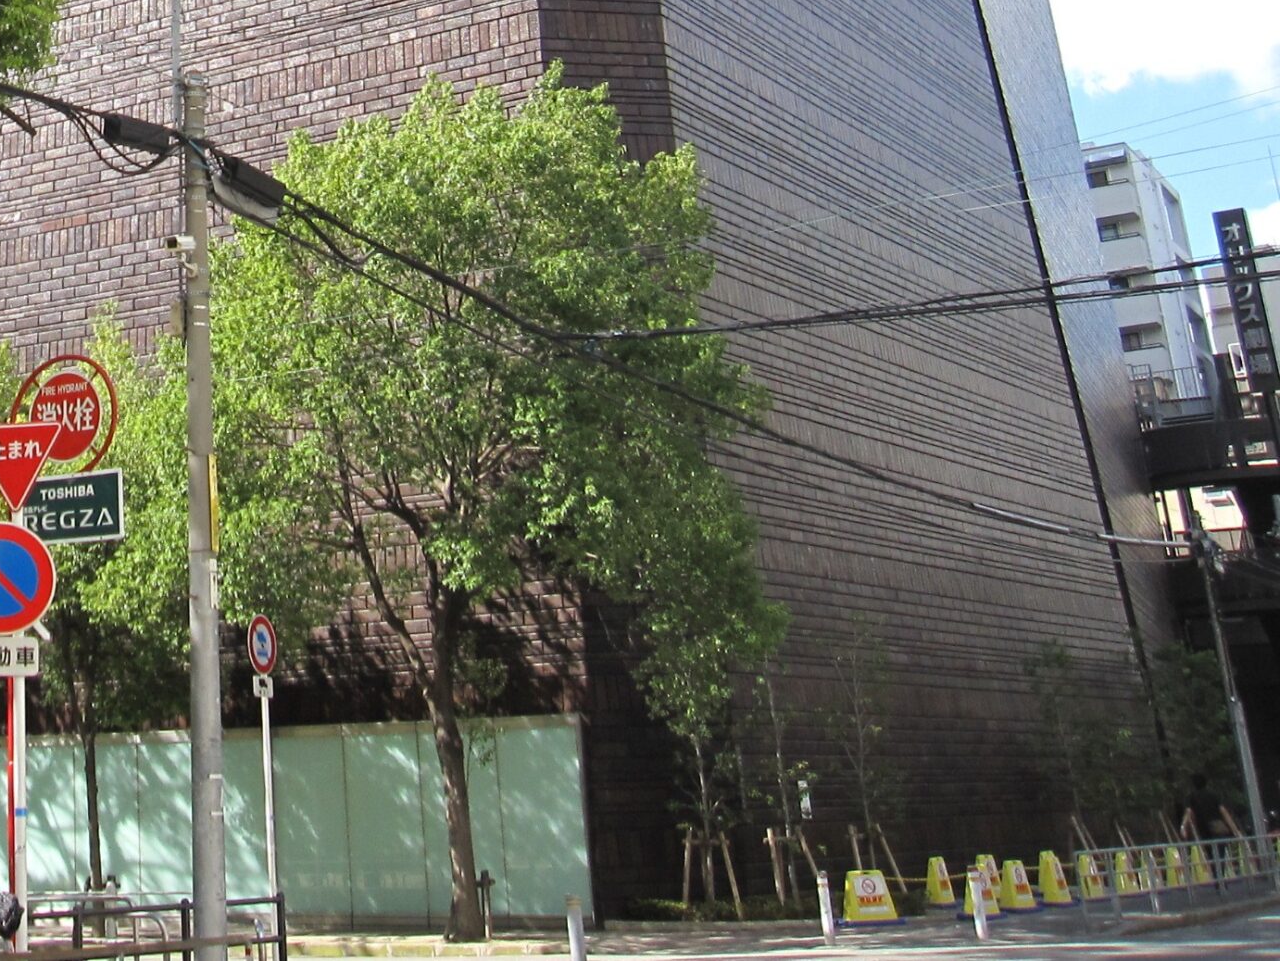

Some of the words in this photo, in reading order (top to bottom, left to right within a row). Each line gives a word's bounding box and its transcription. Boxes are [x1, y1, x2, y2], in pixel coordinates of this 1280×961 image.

[41, 385, 56, 396] FIRE
[57, 382, 88, 394] HYDRANT
[36, 397, 96, 432] 消火栓
[40, 484, 95, 501] TOSHIBA
[23, 507, 114, 532] REGZA
